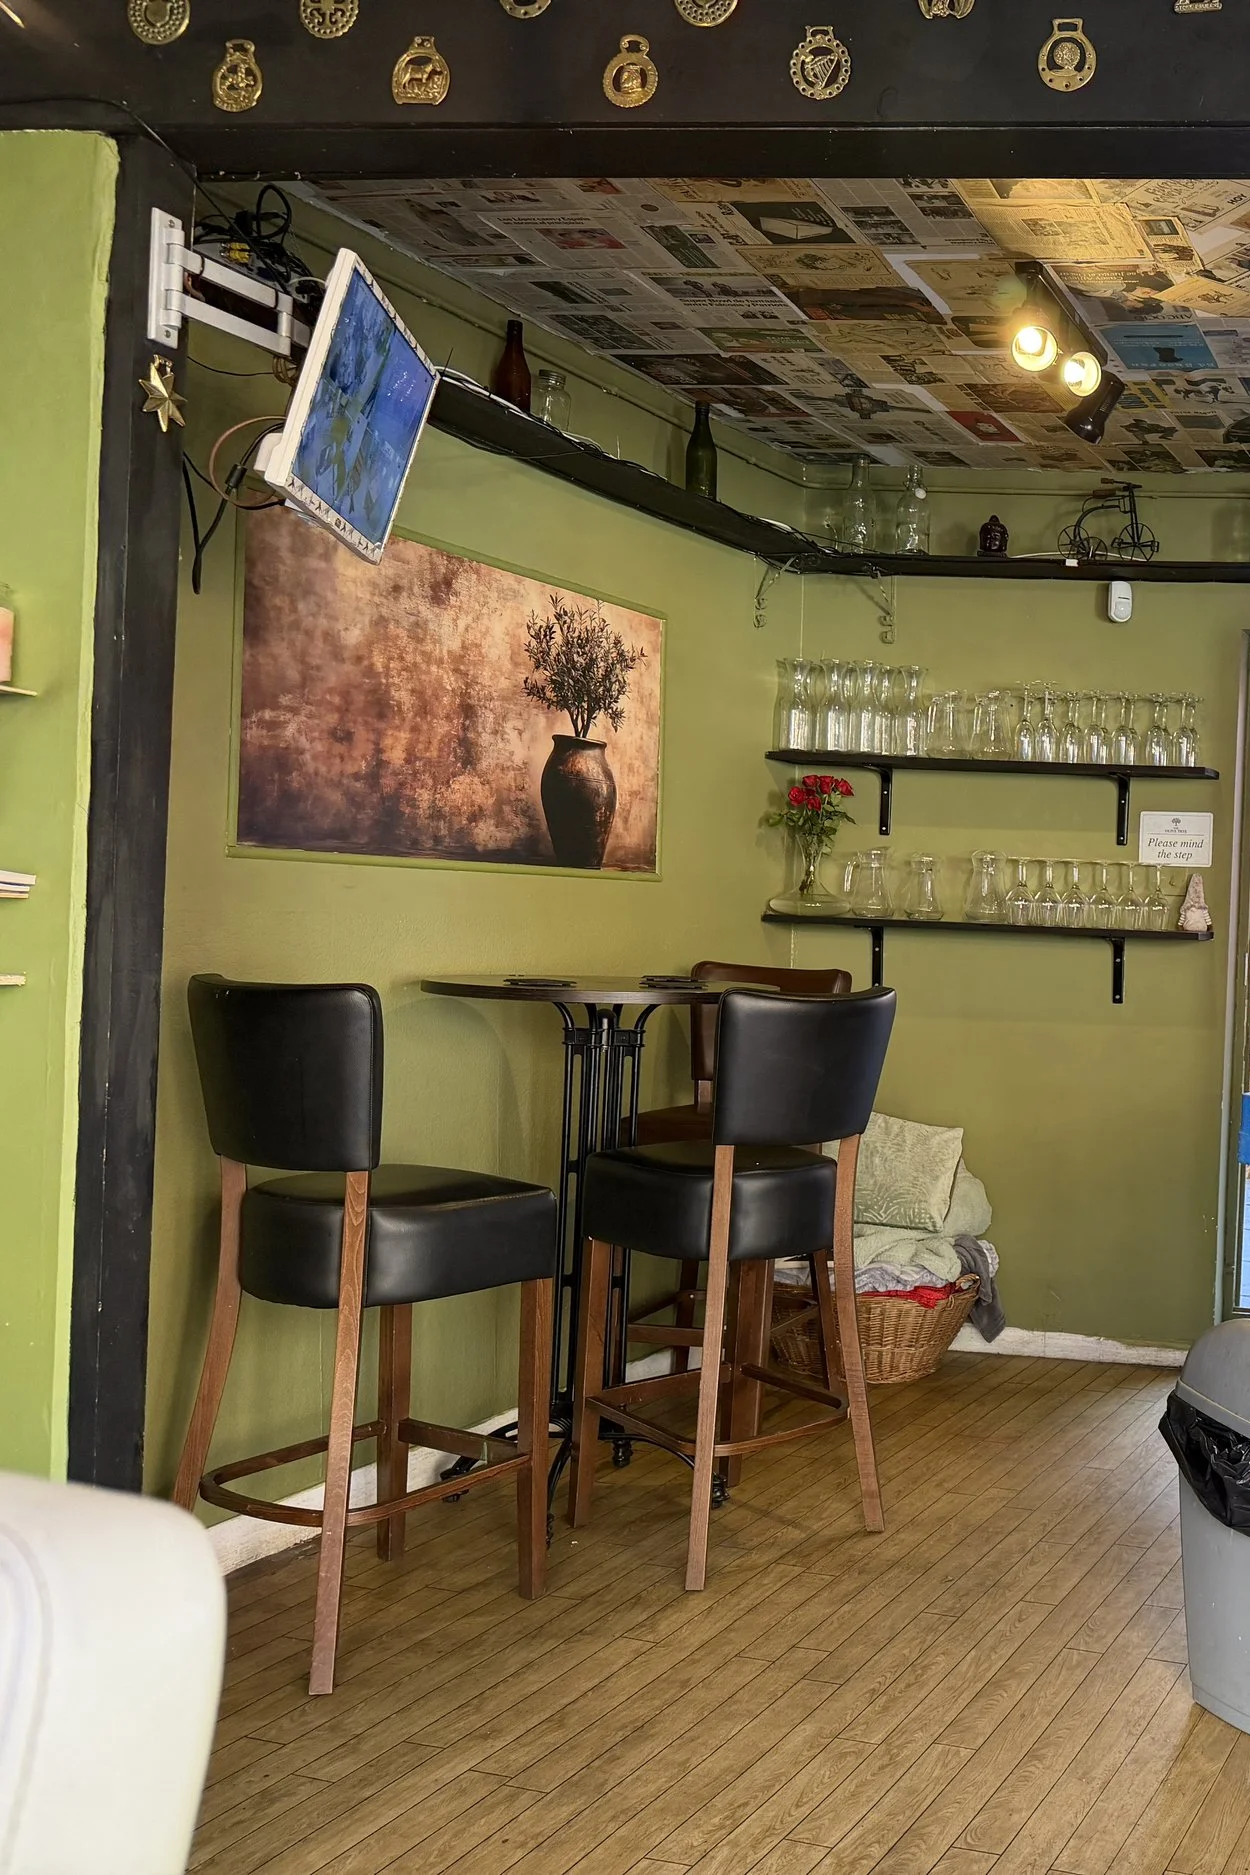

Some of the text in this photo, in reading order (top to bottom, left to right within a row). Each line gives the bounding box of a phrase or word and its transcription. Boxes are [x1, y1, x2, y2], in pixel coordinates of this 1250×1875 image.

[1147, 837, 1204, 848] Please mind
[1157, 849, 1193, 861] the step
